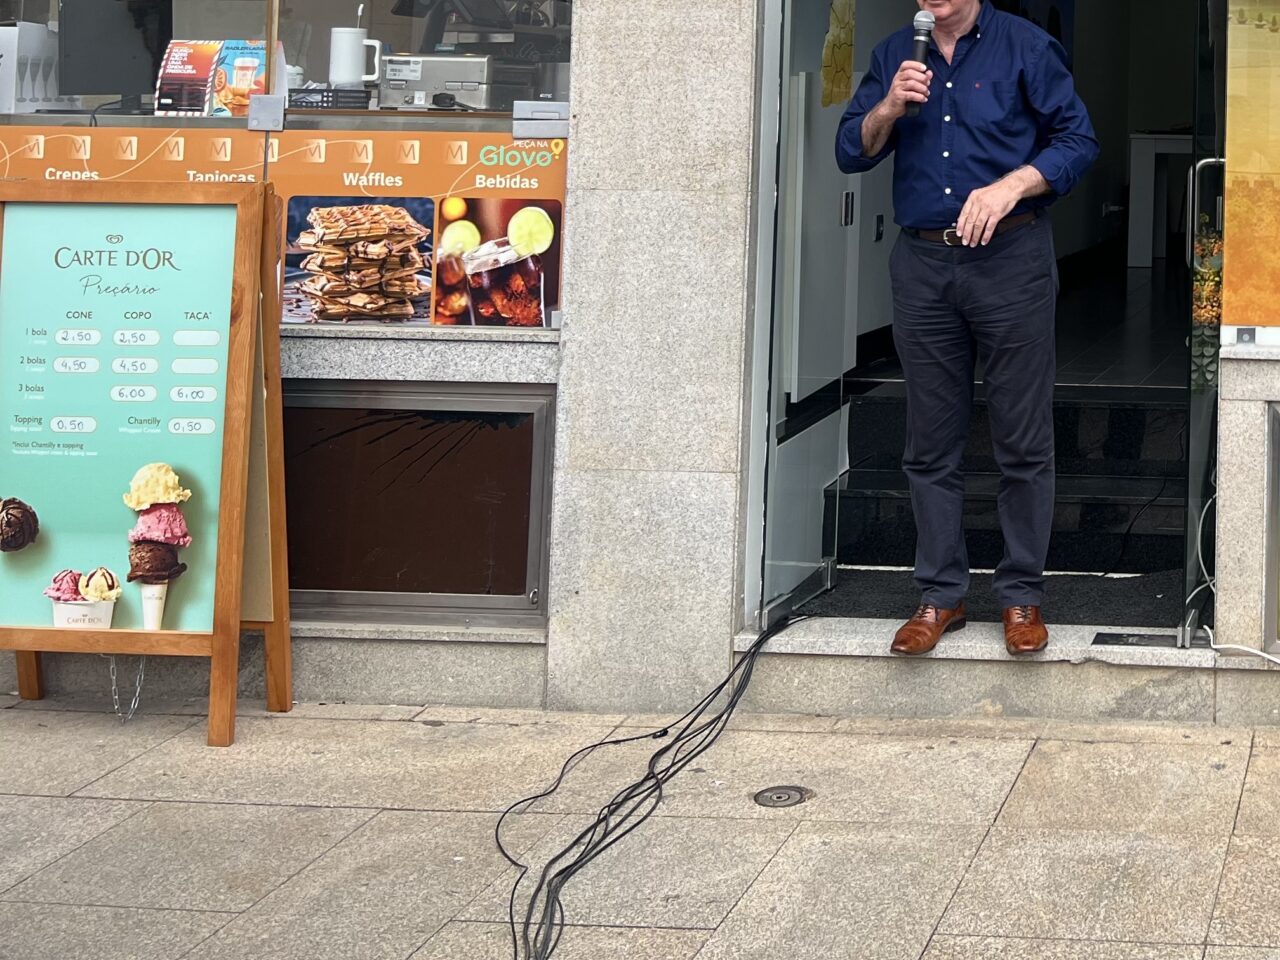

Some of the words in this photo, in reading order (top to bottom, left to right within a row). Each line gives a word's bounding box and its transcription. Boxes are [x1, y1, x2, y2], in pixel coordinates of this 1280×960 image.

[513, 140, 534, 149] PEÇA
[537, 140, 548, 148] NA
[480, 145, 552, 167] Glovo
[45, 168, 100, 181] Crepes
[343, 172, 403, 187] Waffles
[475, 174, 539, 189] Bebidas
[54, 246, 118, 269] CARTE
[79, 274, 161, 297] Preçário
[66, 311, 93, 319] CONE
[124, 311, 152, 320] COPO
[32, 328, 47, 336] bola
[20, 356, 25, 364] 2
[27, 356, 46, 364] bolas
[25, 384, 45, 392] bolas
[14, 415, 43, 426] Topping
[128, 416, 162, 427] Chantilly
